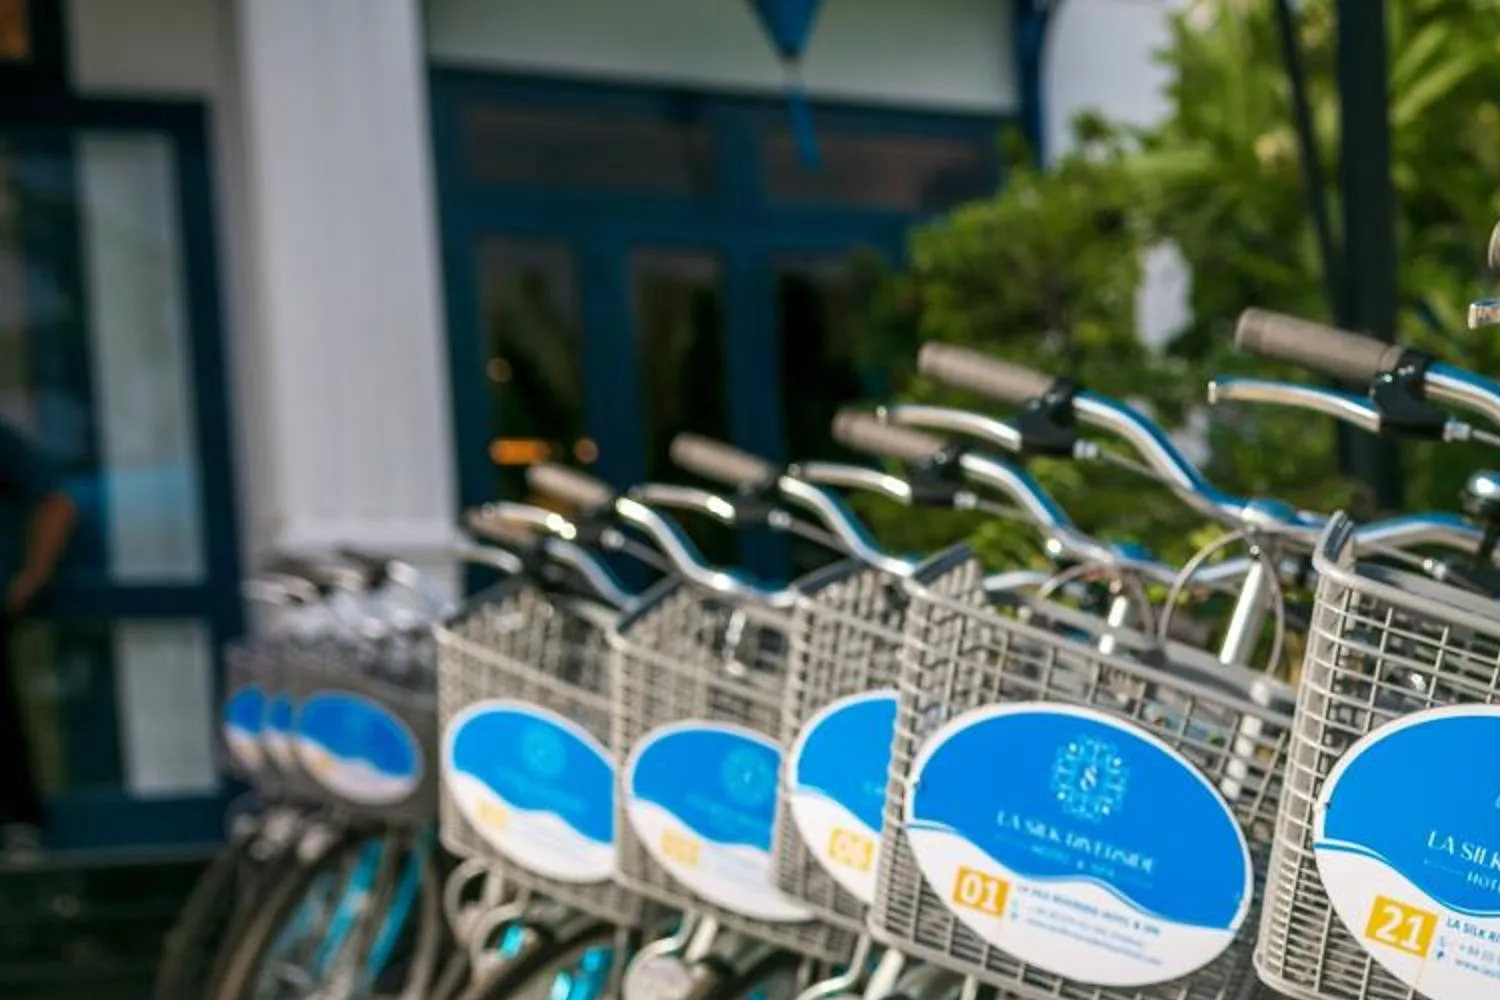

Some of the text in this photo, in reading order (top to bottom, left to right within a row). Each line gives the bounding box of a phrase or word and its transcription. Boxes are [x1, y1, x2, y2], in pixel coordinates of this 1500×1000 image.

[1427, 830, 1455, 856] LA
[960, 872, 998, 911] 01
[1376, 905, 1424, 952] 21
[1463, 923, 1485, 938] SILK
